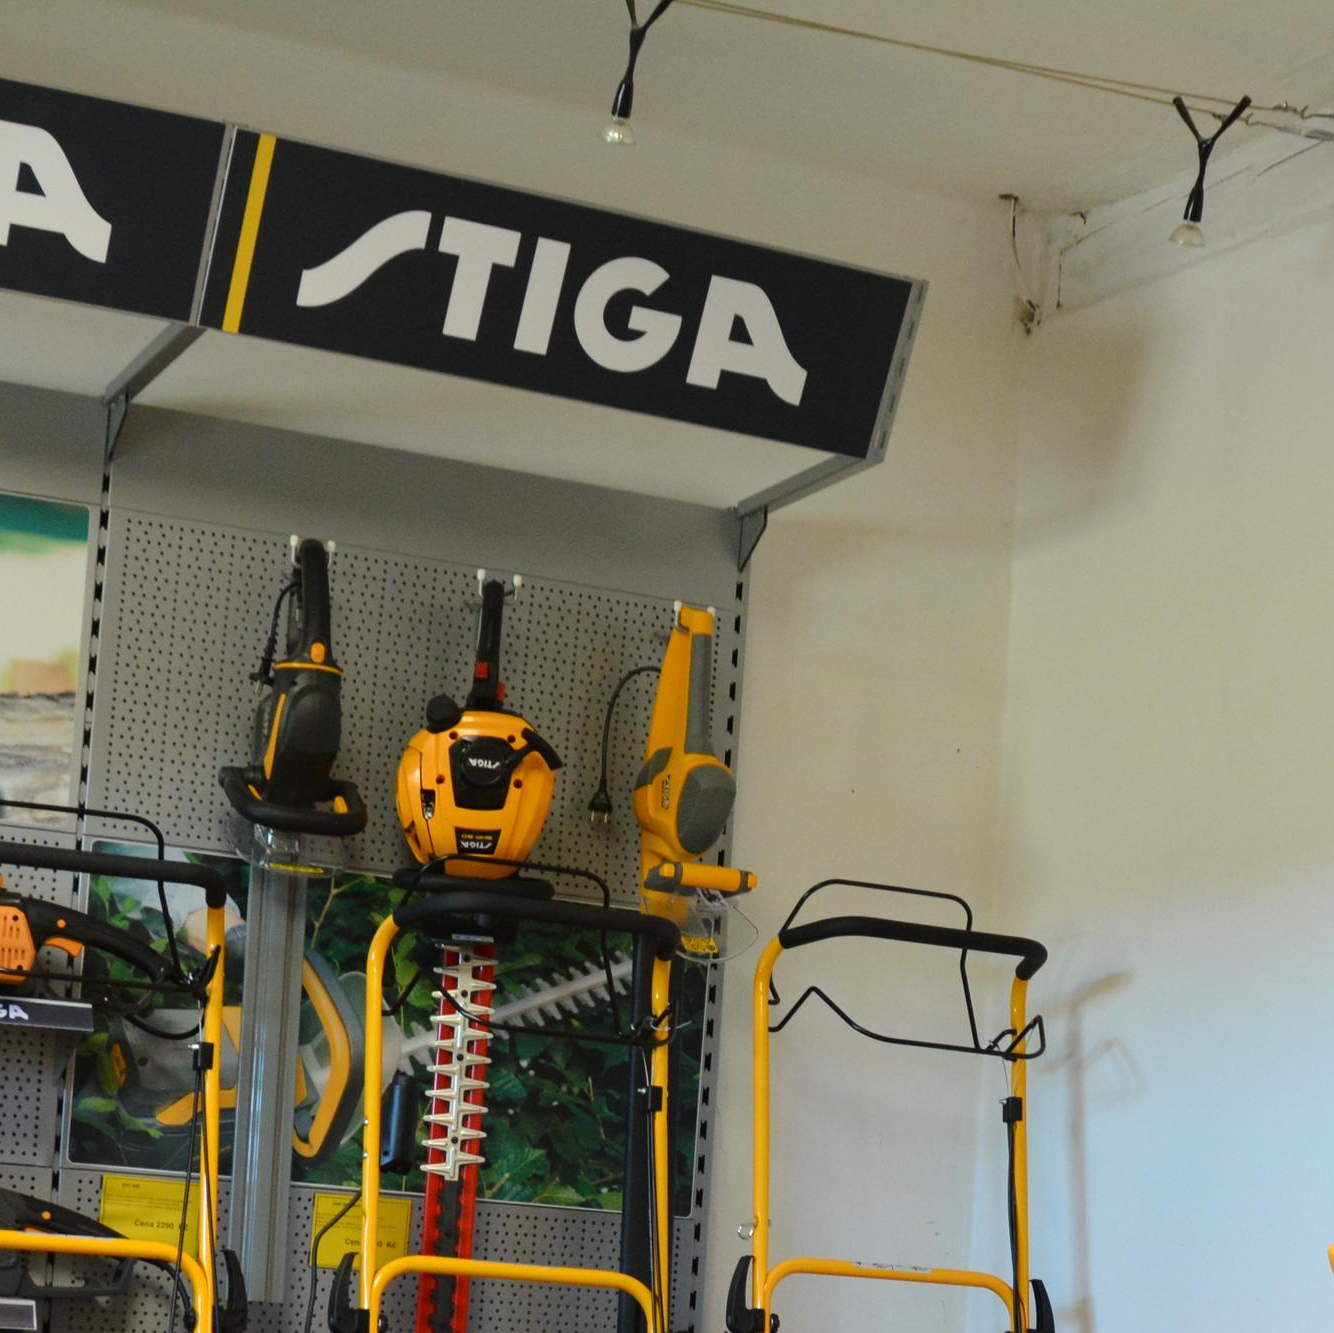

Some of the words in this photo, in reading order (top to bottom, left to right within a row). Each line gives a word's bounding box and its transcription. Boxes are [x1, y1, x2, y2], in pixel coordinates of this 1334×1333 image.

[296, 210, 808, 407] STIGA
[468, 758, 500, 770] STIGA
[460, 841, 493, 849] STIGA
[345, 1239, 361, 1248] Cen
